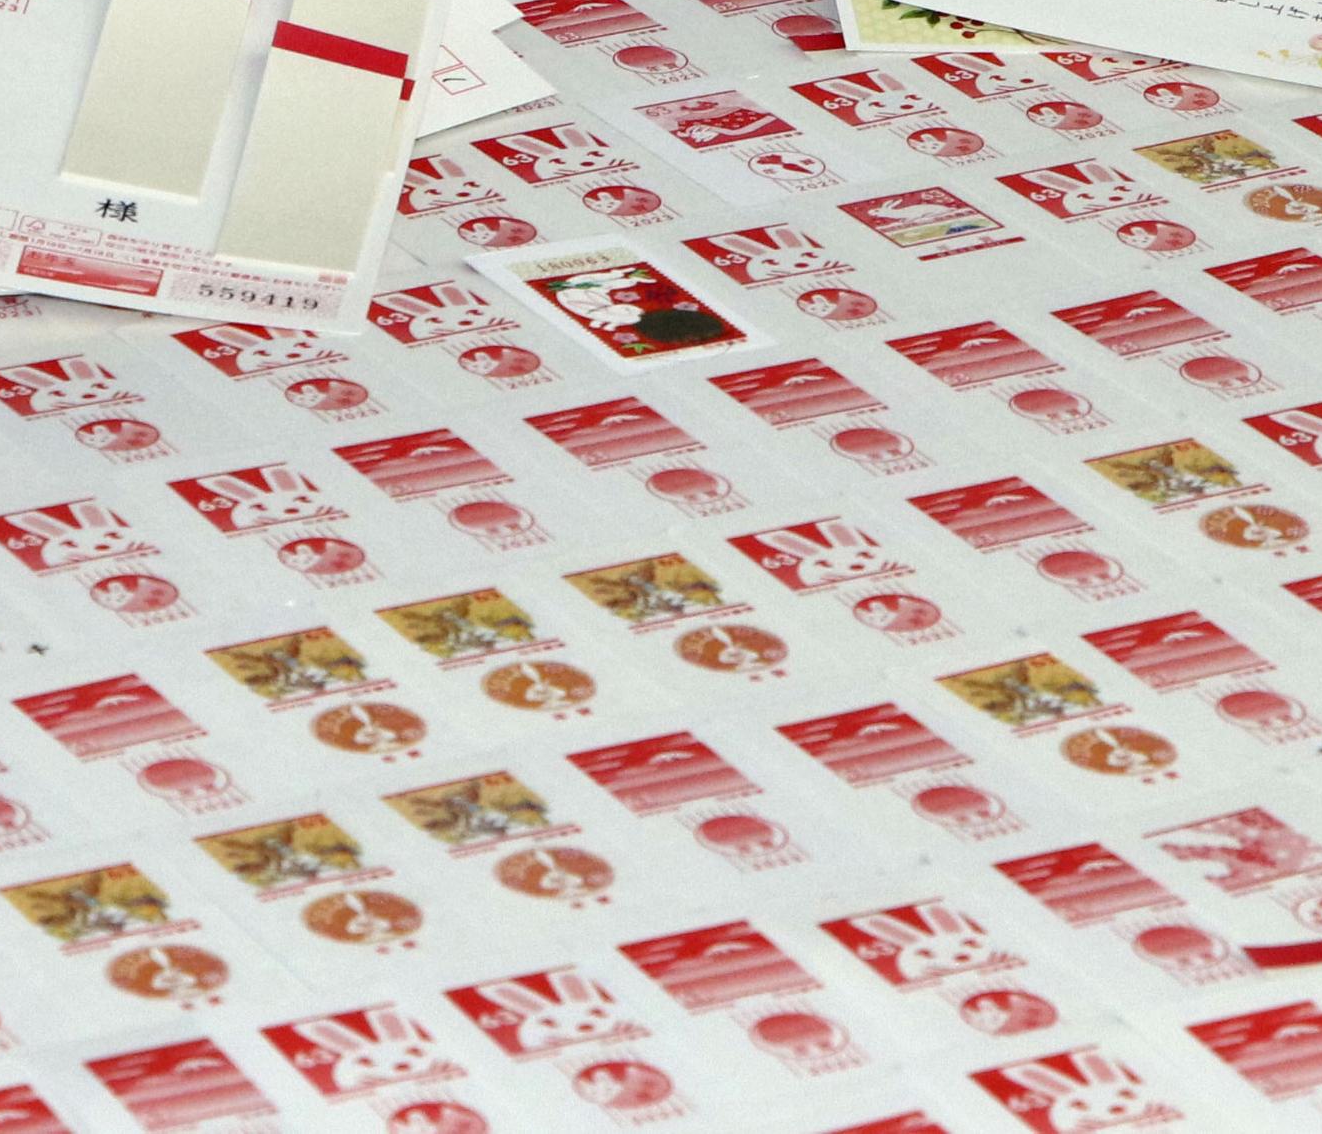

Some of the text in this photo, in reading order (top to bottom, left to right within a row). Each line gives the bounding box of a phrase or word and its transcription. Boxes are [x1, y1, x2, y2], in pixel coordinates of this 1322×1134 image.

[822, 97, 855, 113] 63
[502, 153, 535, 168] 63
[1029, 188, 1062, 202] 63
[96, 198, 138, 223] 様
[713, 252, 747, 267] 63
[198, 283, 319, 311] 559419
[1278, 431, 1315, 448] 63
